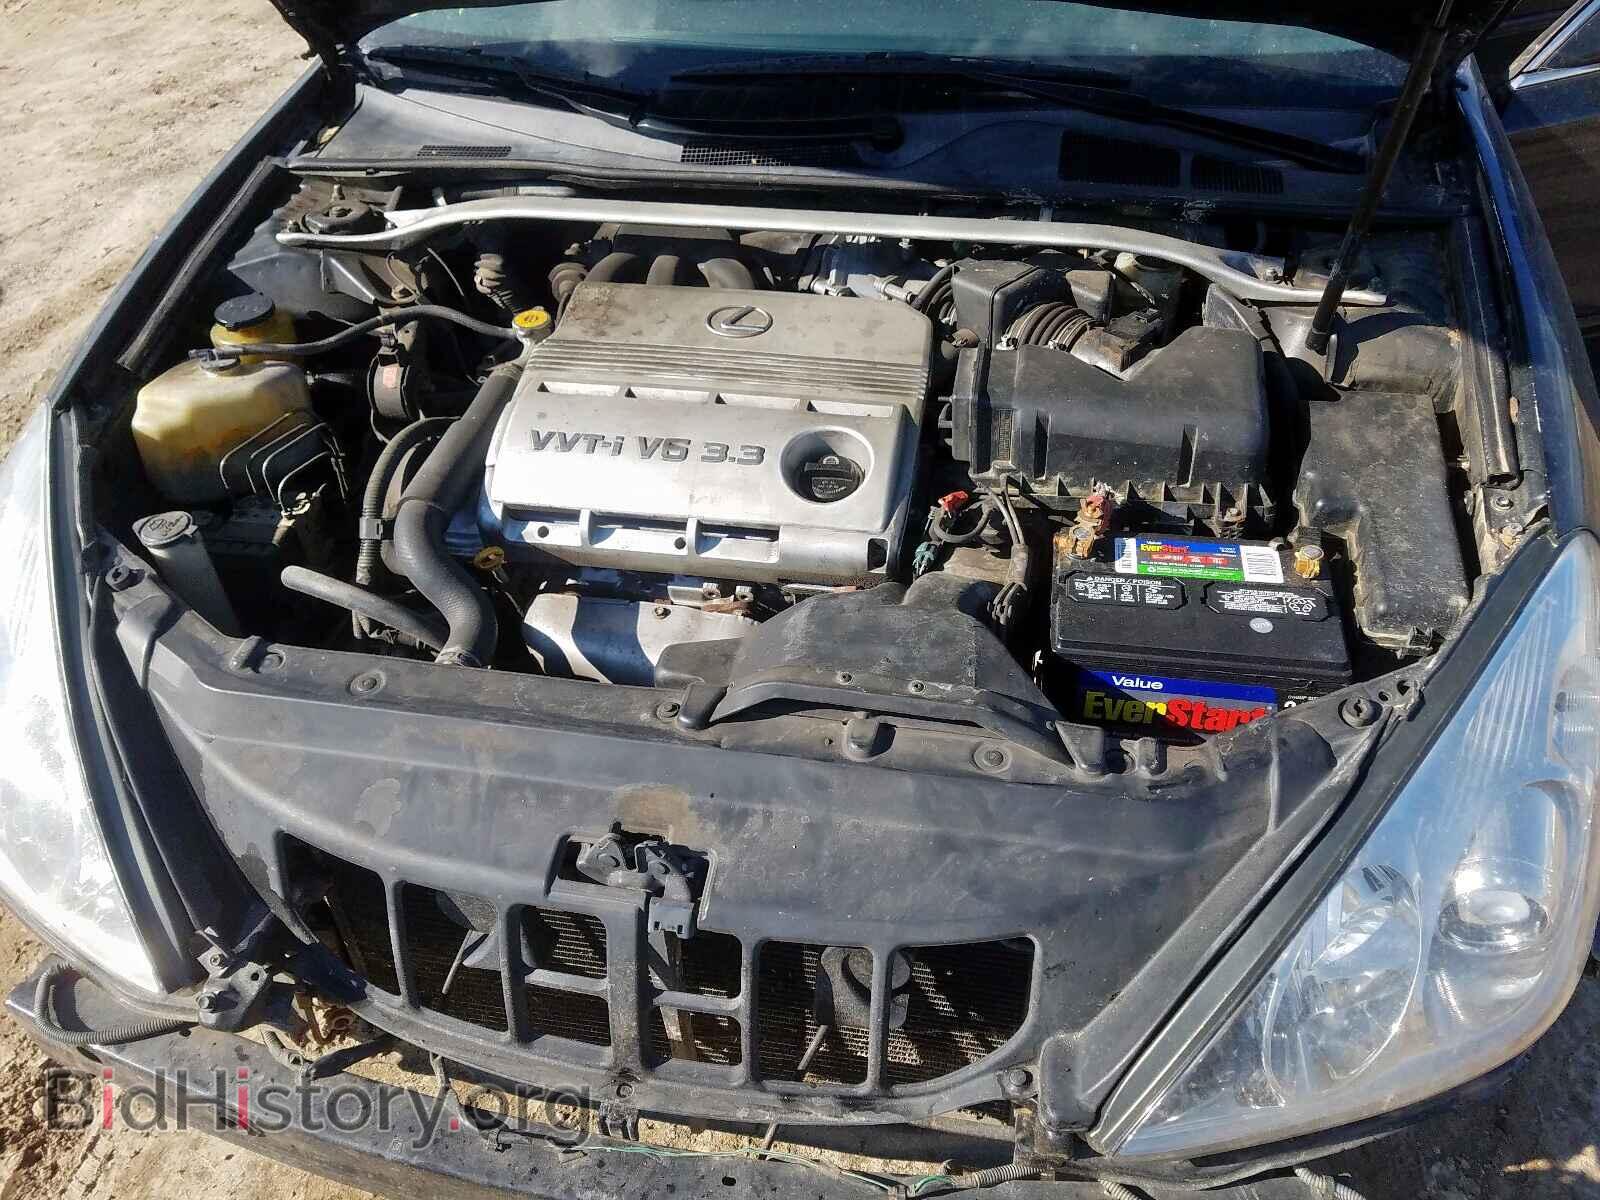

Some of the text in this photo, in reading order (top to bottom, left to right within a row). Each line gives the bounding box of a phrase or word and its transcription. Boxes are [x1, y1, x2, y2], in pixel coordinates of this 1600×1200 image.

[530, 429, 766, 466] VVT-i V6 3.3
[1112, 675, 1164, 690] Value
